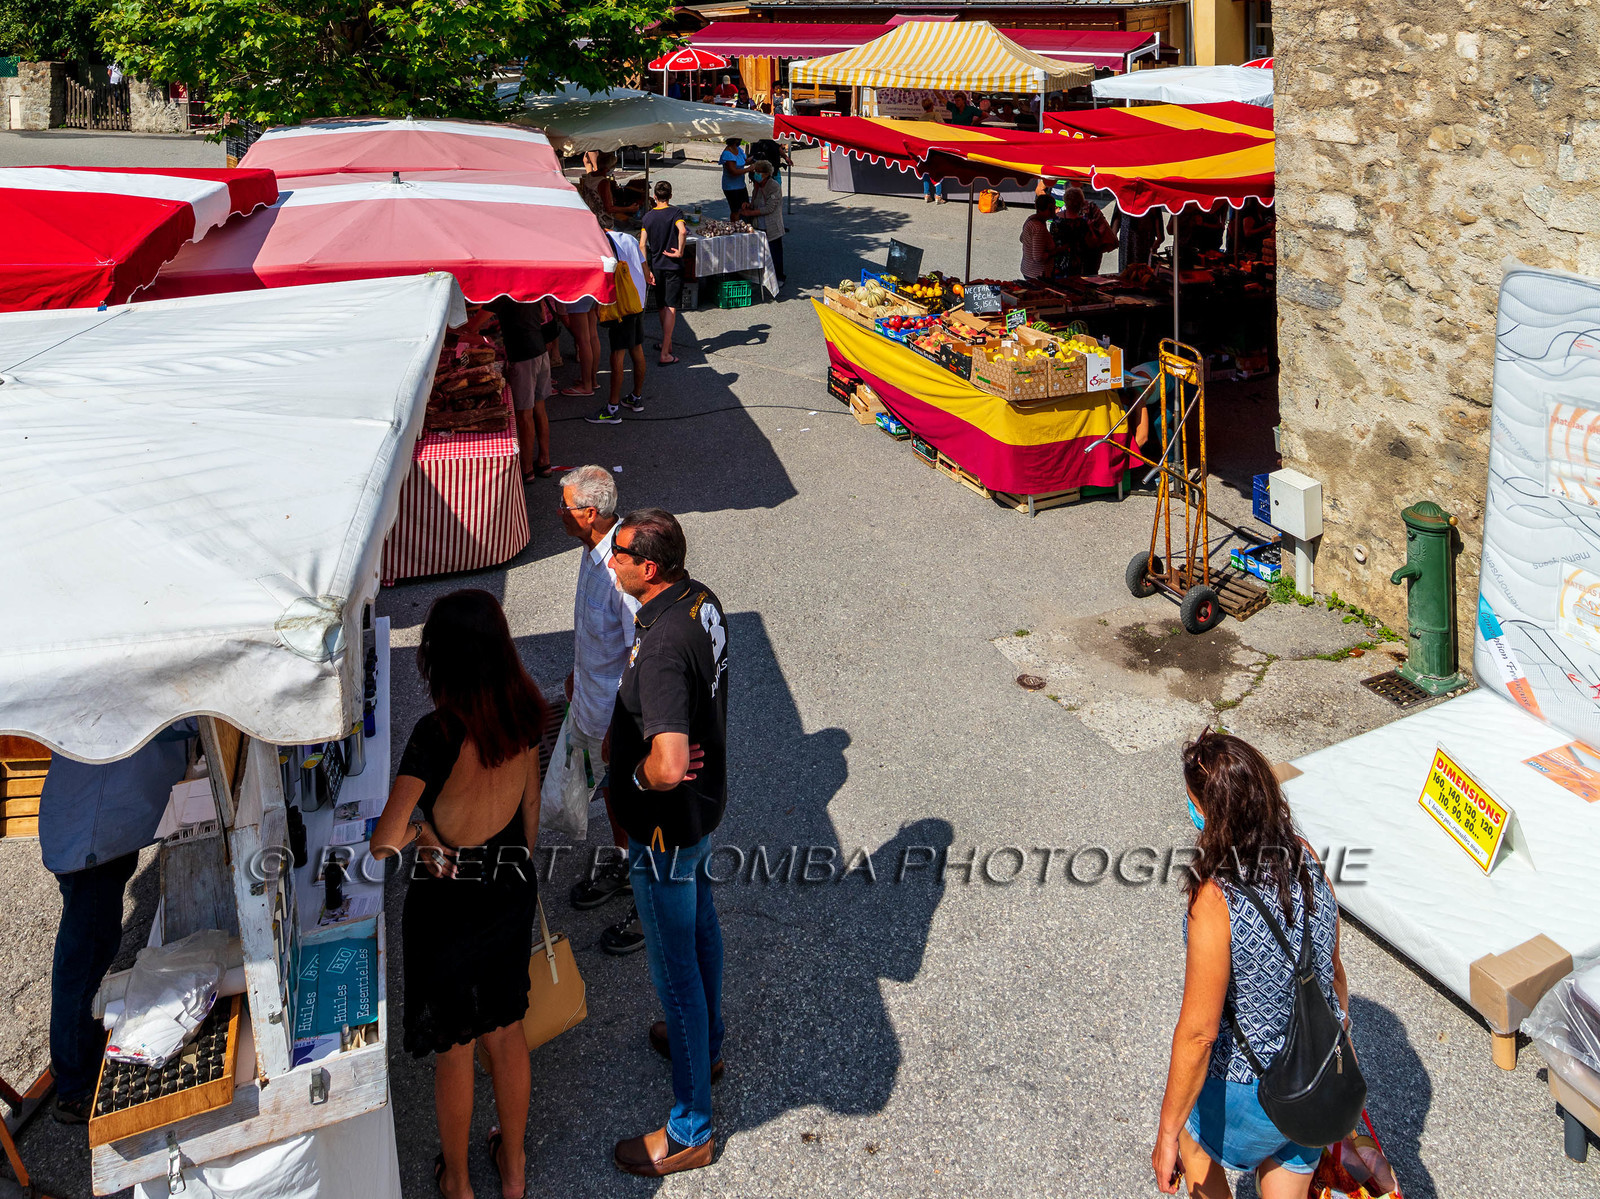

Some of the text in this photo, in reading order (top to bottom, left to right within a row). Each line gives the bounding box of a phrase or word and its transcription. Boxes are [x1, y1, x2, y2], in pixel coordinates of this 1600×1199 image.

[1432, 772, 1494, 839] 160, 140, 130, 120,
[1436, 756, 1502, 826] DIMENSIONS
[1438, 792, 1449, 810] 110,
[1452, 805, 1462, 823] 90,
[332, 950, 352, 970] BIO
[334, 984, 347, 1025] Huiles
[356, 948, 370, 1020] Essentielles
[298, 991, 317, 1032] Huiles
